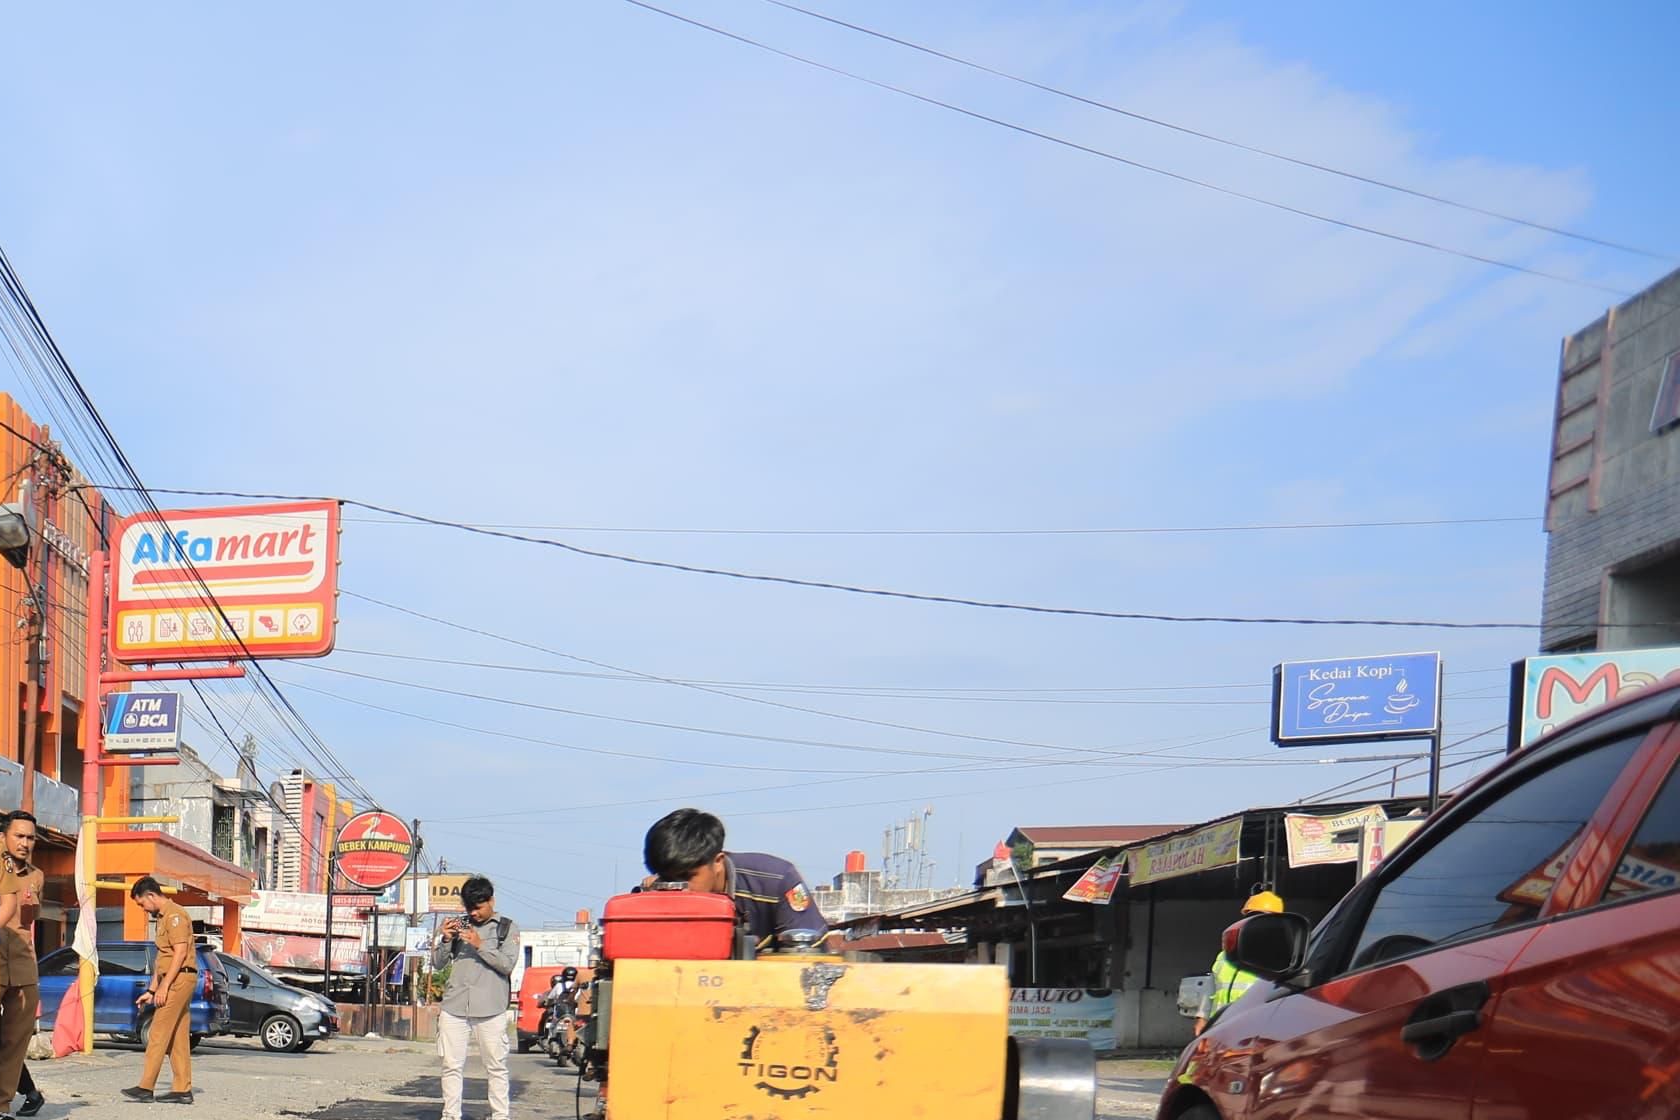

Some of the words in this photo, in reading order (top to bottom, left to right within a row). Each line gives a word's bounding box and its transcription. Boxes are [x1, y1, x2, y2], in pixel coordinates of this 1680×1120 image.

[132, 523, 317, 566] Alfamart
[1309, 666, 1352, 682] Kedai
[1356, 663, 1393, 680] Kopi
[130, 698, 162, 712] ATM
[138, 713, 168, 727] BCA
[339, 841, 367, 853] BEBEK
[367, 840, 411, 855] KAMPUNG
[1031, 989, 1084, 1003] AUTO
[736, 1062, 838, 1082] TIGON
